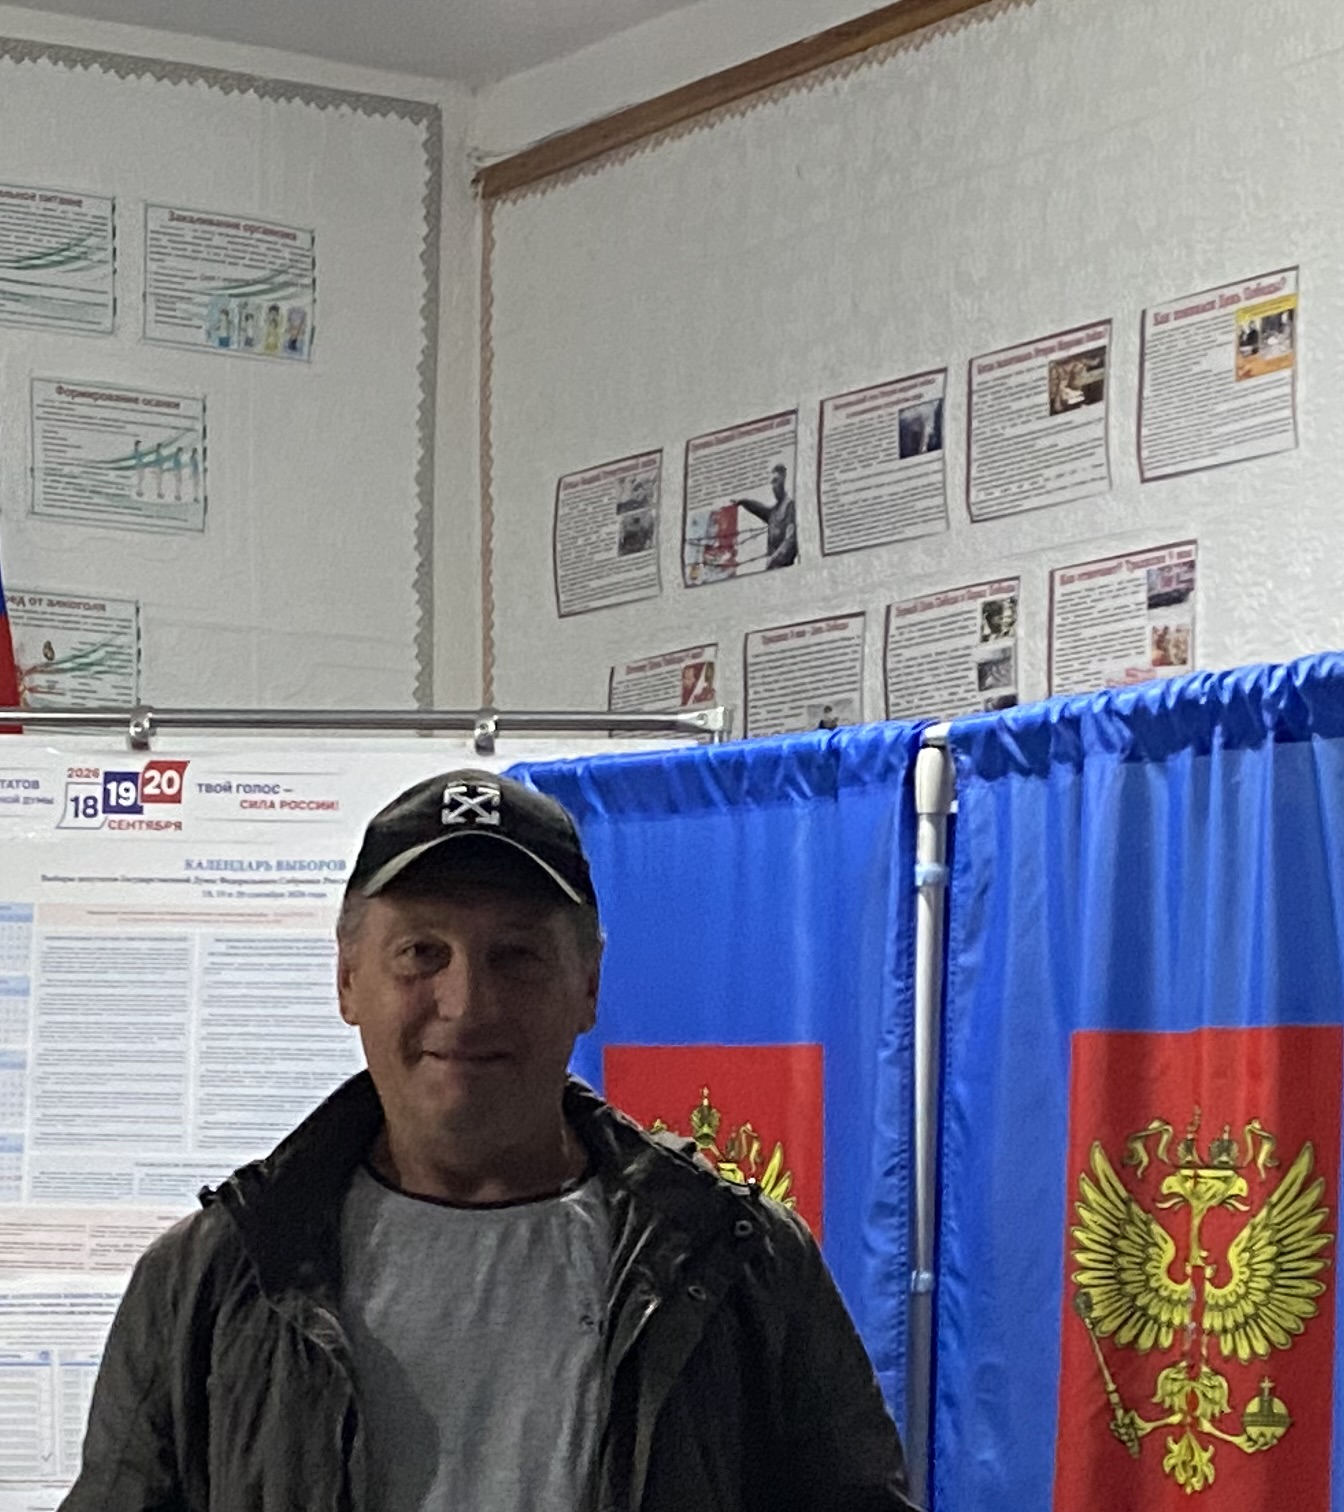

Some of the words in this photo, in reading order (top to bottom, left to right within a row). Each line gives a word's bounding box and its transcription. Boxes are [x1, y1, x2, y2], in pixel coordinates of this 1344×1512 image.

[67, 767, 100, 780] 2026
[143, 769, 182, 796] 20
[197, 780, 233, 794] ТВОЙ
[235, 782, 283, 796] ГОЛОС
[105, 780, 137, 807] 19
[70, 796, 99, 819] 18
[239, 798, 276, 811] СИЛА
[278, 798, 340, 812] РОССИИ!
[107, 819, 183, 832] СЕНТЯБРЯ
